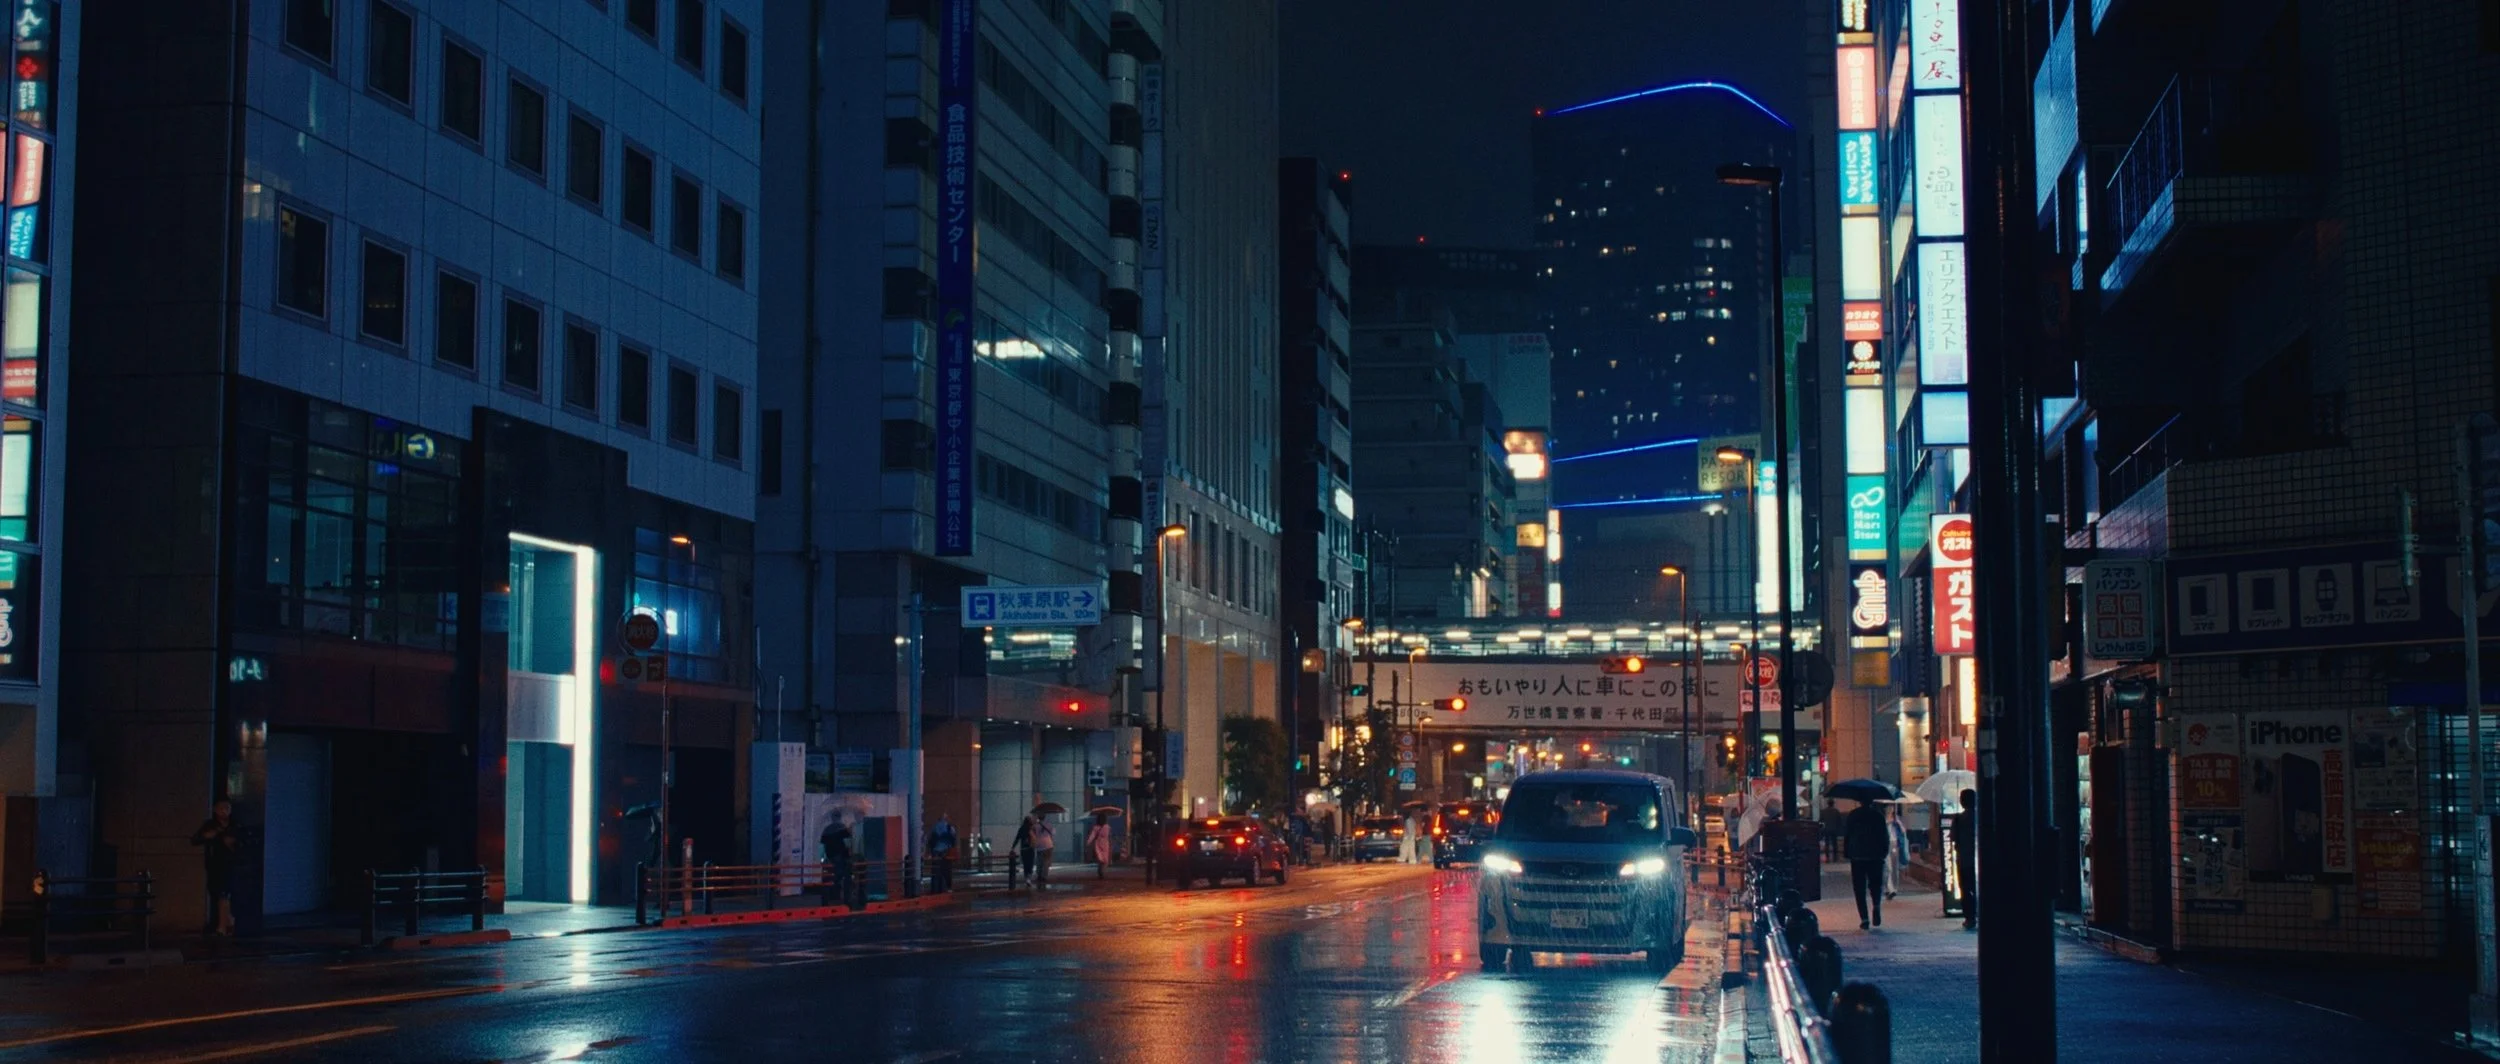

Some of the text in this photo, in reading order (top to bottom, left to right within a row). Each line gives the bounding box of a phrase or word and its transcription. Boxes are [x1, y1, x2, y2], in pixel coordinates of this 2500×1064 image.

[1845, 139, 1858, 199] クリニック
[947, 103, 967, 263] 食品技術センター
[1939, 249, 1957, 350] エリアクエスト
[1701, 469, 1760, 485] RESORS
[2101, 567, 2135, 578] スマホ
[2096, 579, 2142, 590] パソコン
[1000, 591, 1070, 609] 秋葉原駅
[1002, 609, 1095, 620] Akihabara Sta. 120m
[2246, 617, 2284, 629] タブレット
[2250, 721, 2342, 745] iPhone
[2196, 781, 2227, 797] 10%
